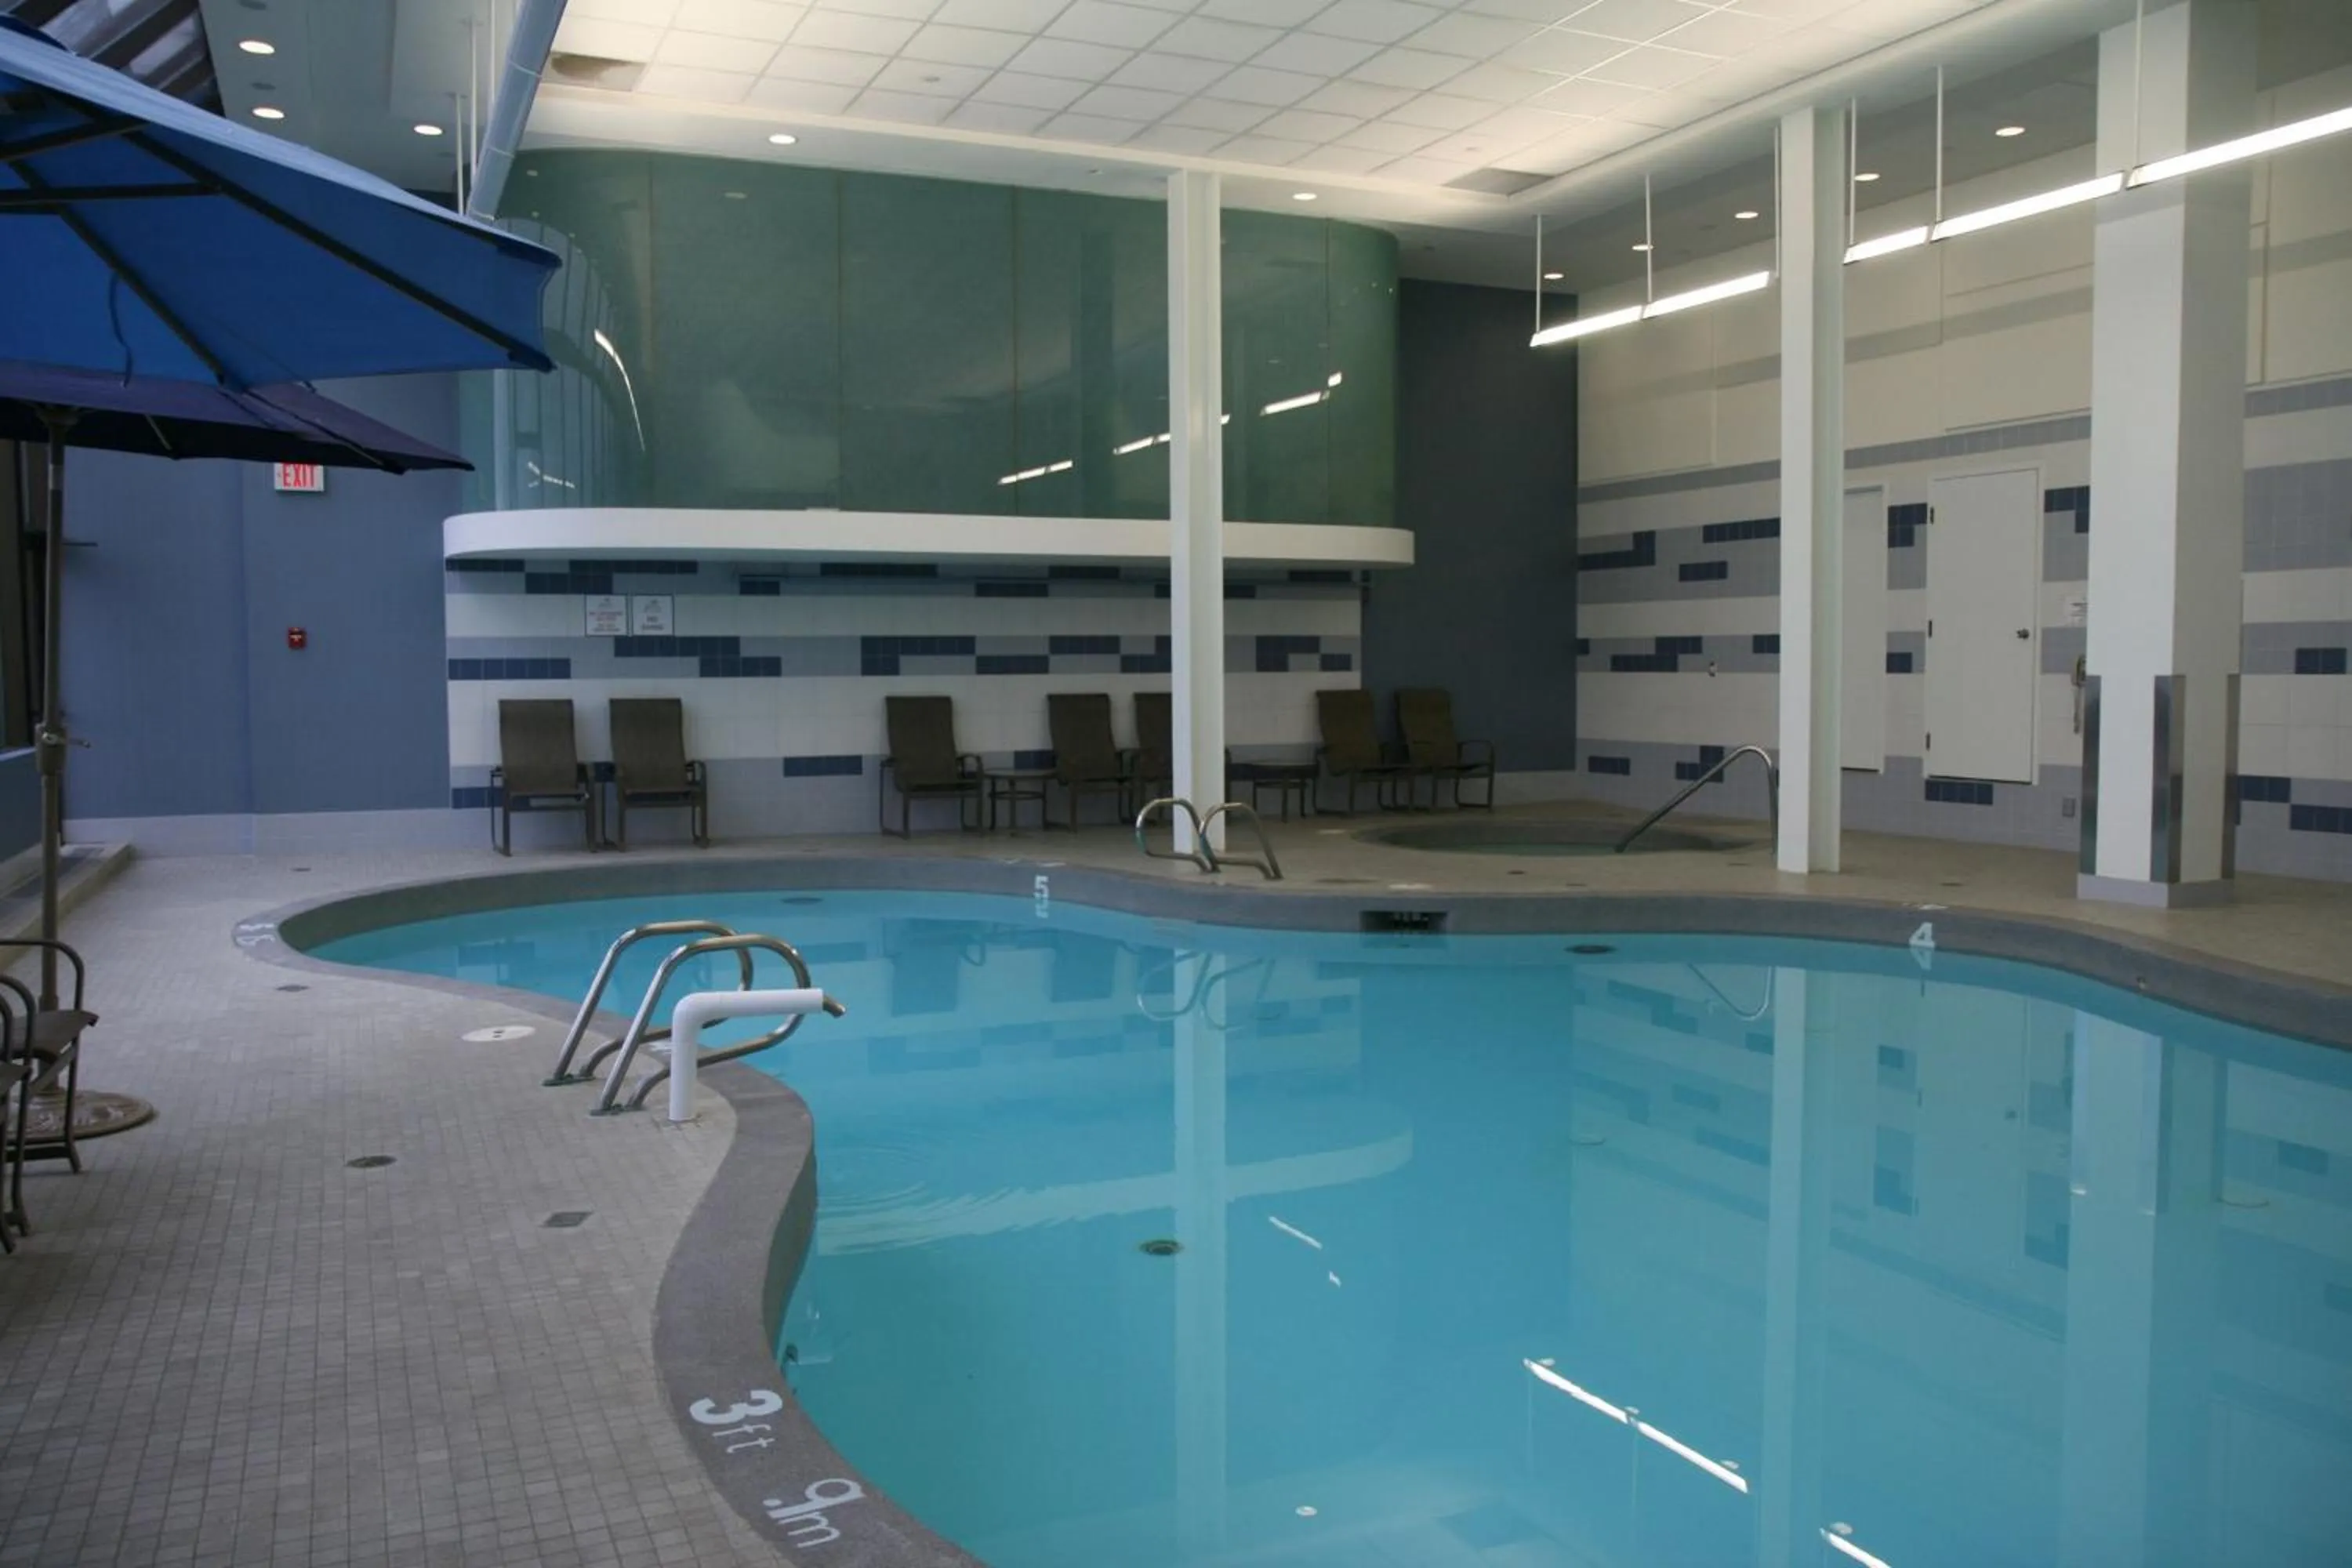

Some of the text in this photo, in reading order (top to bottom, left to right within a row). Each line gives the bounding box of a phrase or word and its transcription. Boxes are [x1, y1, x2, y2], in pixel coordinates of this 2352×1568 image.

[283, 463, 314, 488] EXIT
[1034, 875, 1050, 899] 5
[1908, 922, 1935, 948] 4
